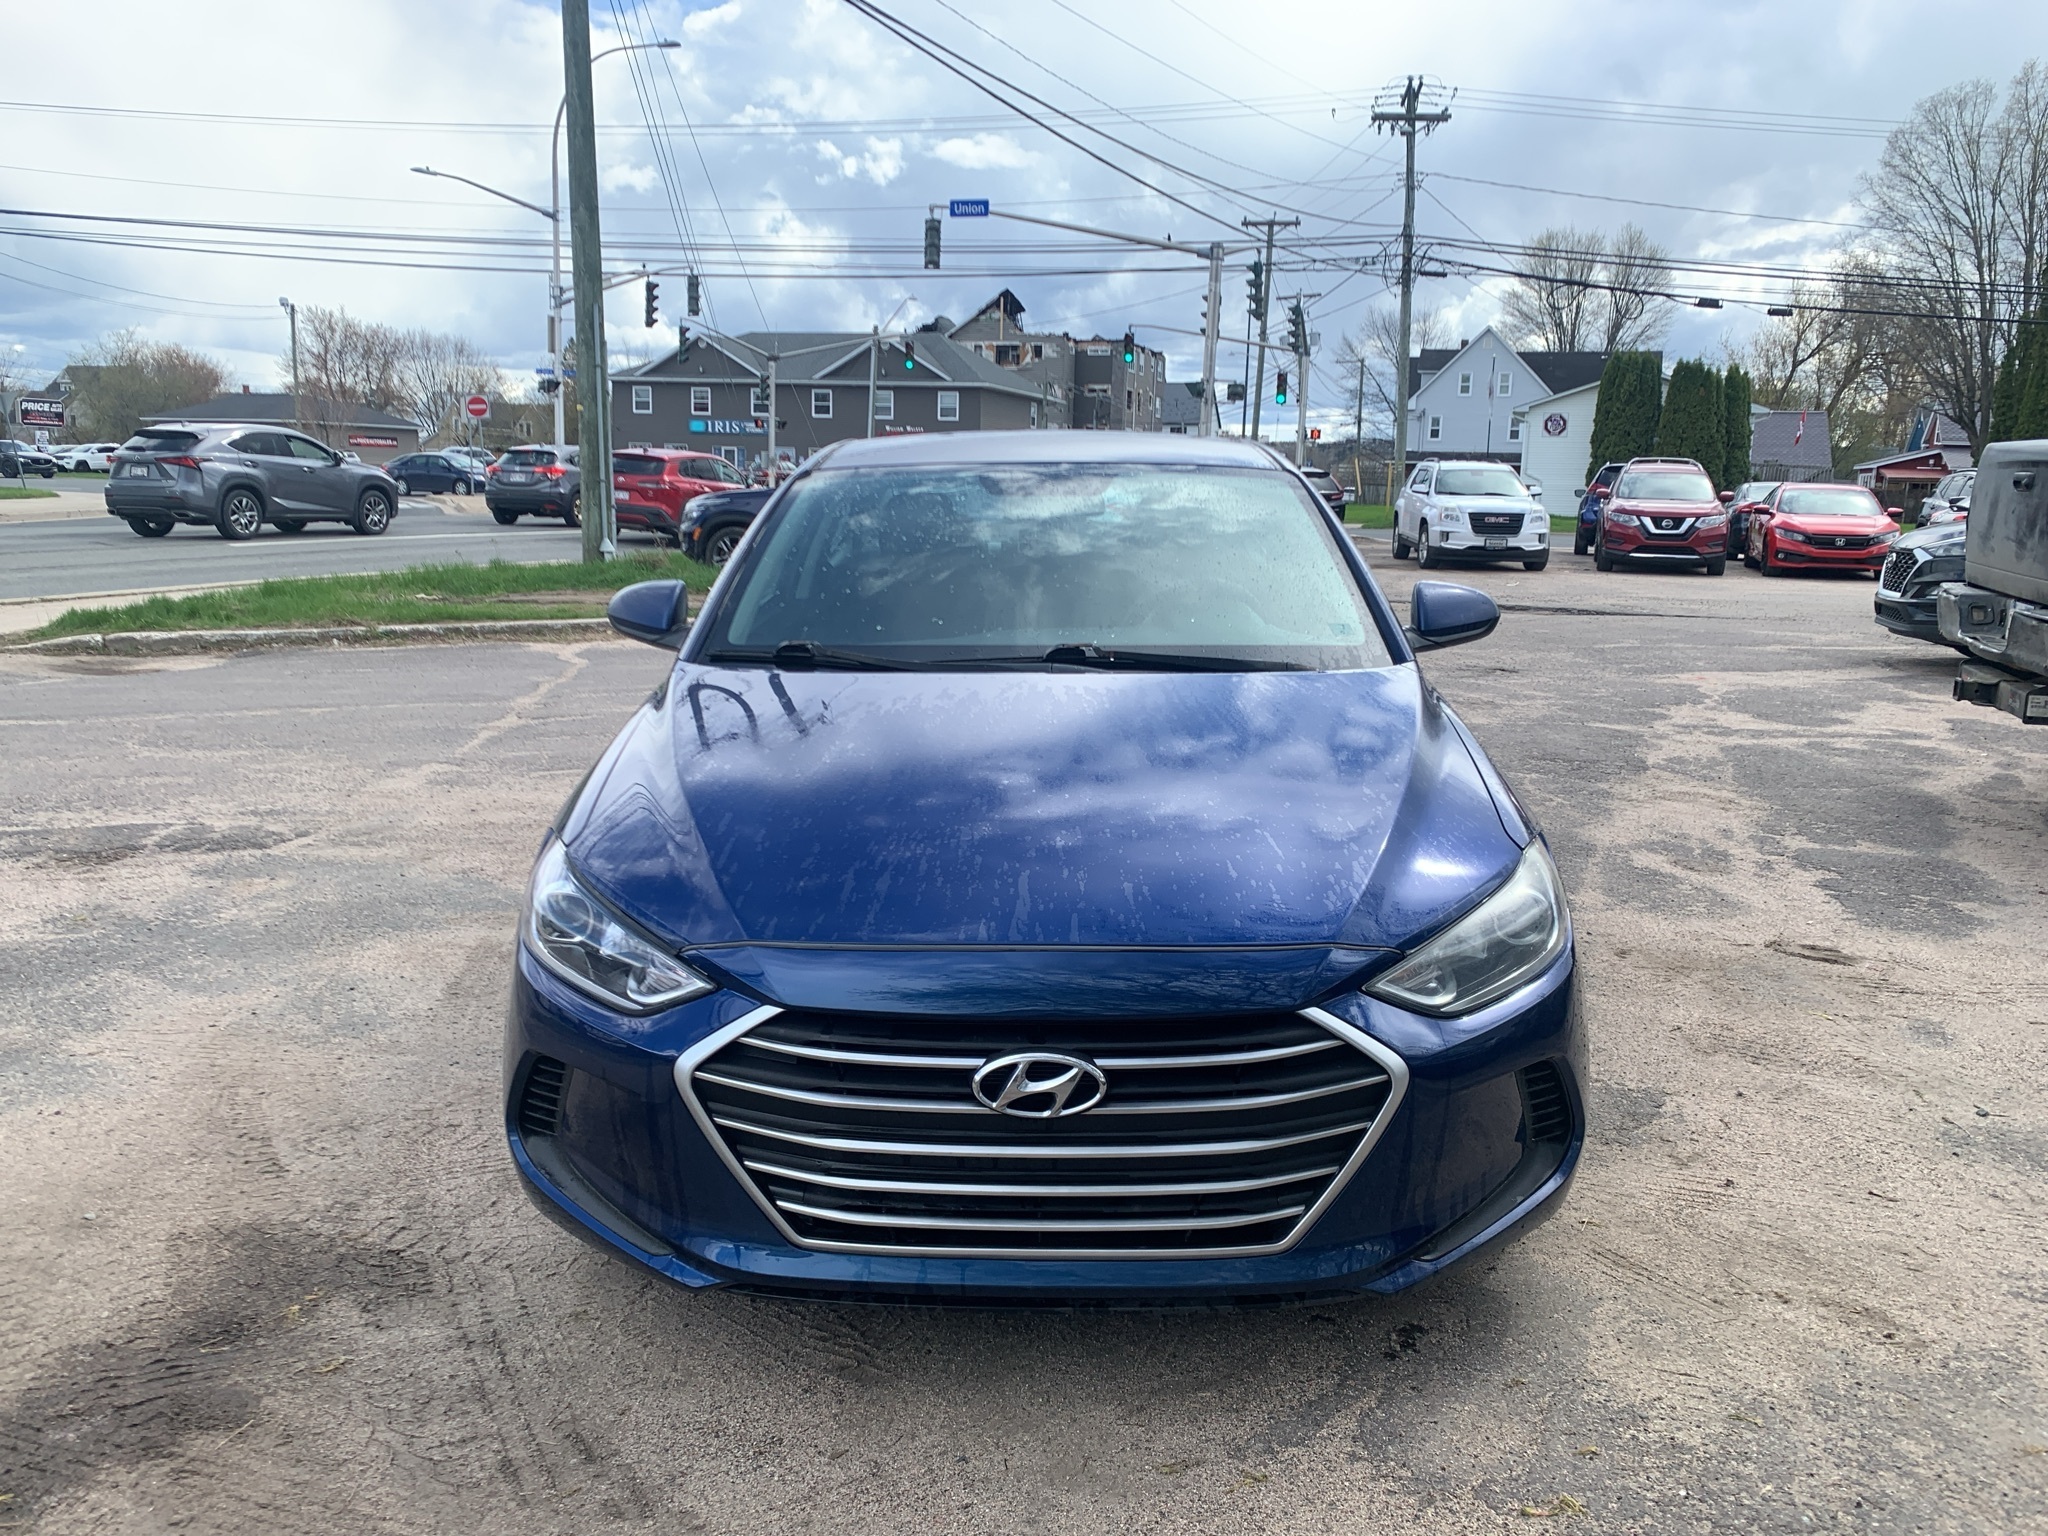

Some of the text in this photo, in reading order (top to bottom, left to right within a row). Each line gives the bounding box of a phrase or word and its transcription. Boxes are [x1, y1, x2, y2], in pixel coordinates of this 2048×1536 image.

[954, 202, 985, 215] Union
[21, 401, 50, 411] PRICE
[707, 420, 740, 434] IRIS
